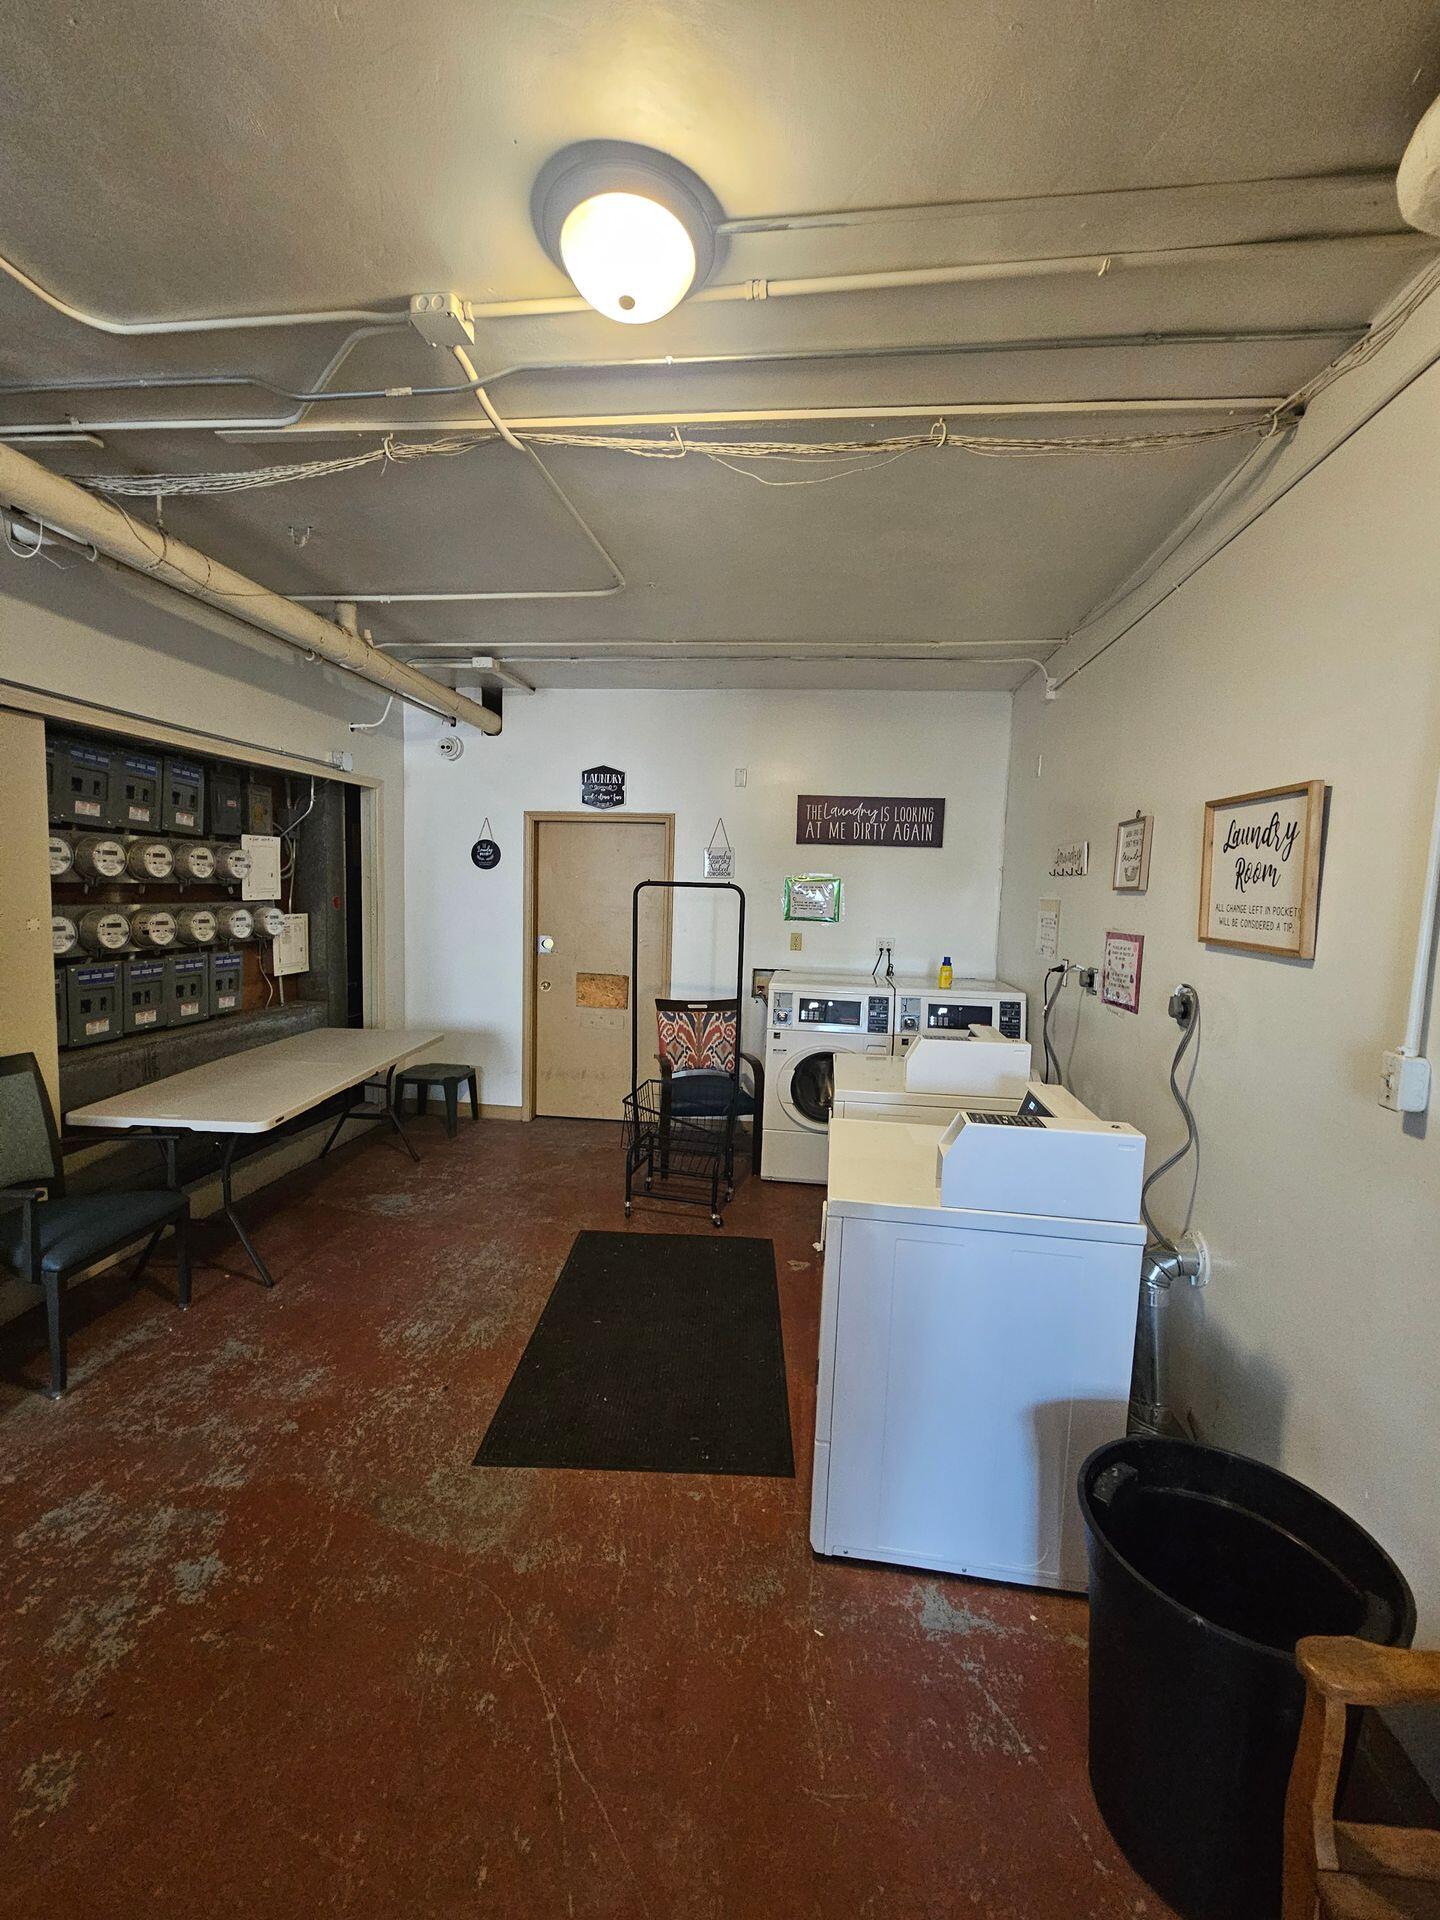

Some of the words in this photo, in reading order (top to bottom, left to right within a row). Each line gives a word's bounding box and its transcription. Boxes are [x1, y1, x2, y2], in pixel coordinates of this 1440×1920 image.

[584, 773, 624, 784] LAUNDRY
[806, 804, 823, 820] THE
[823, 802, 879, 824] Laundry
[880, 806, 891, 822] IS
[894, 806, 935, 823] LOOKING
[805, 821, 824, 839] AT
[828, 821, 847, 840] ME
[853, 822, 888, 841] DIRTY
[892, 823, 934, 842] AGAIN
[1223, 811, 1301, 862] Laundry
[1235, 857, 1282, 894] Room
[1215, 903, 1226, 913] ALL
[1226, 904, 1247, 914] CHANGE
[1249, 905, 1264, 915] LEFT
[1264, 907, 1272, 915] IN
[1218, 916, 1231, 927] WILL
[1231, 918, 1239, 928] BE
[1240, 919, 1275, 931] CONSIDERED
[1276, 922, 1282, 932] A
